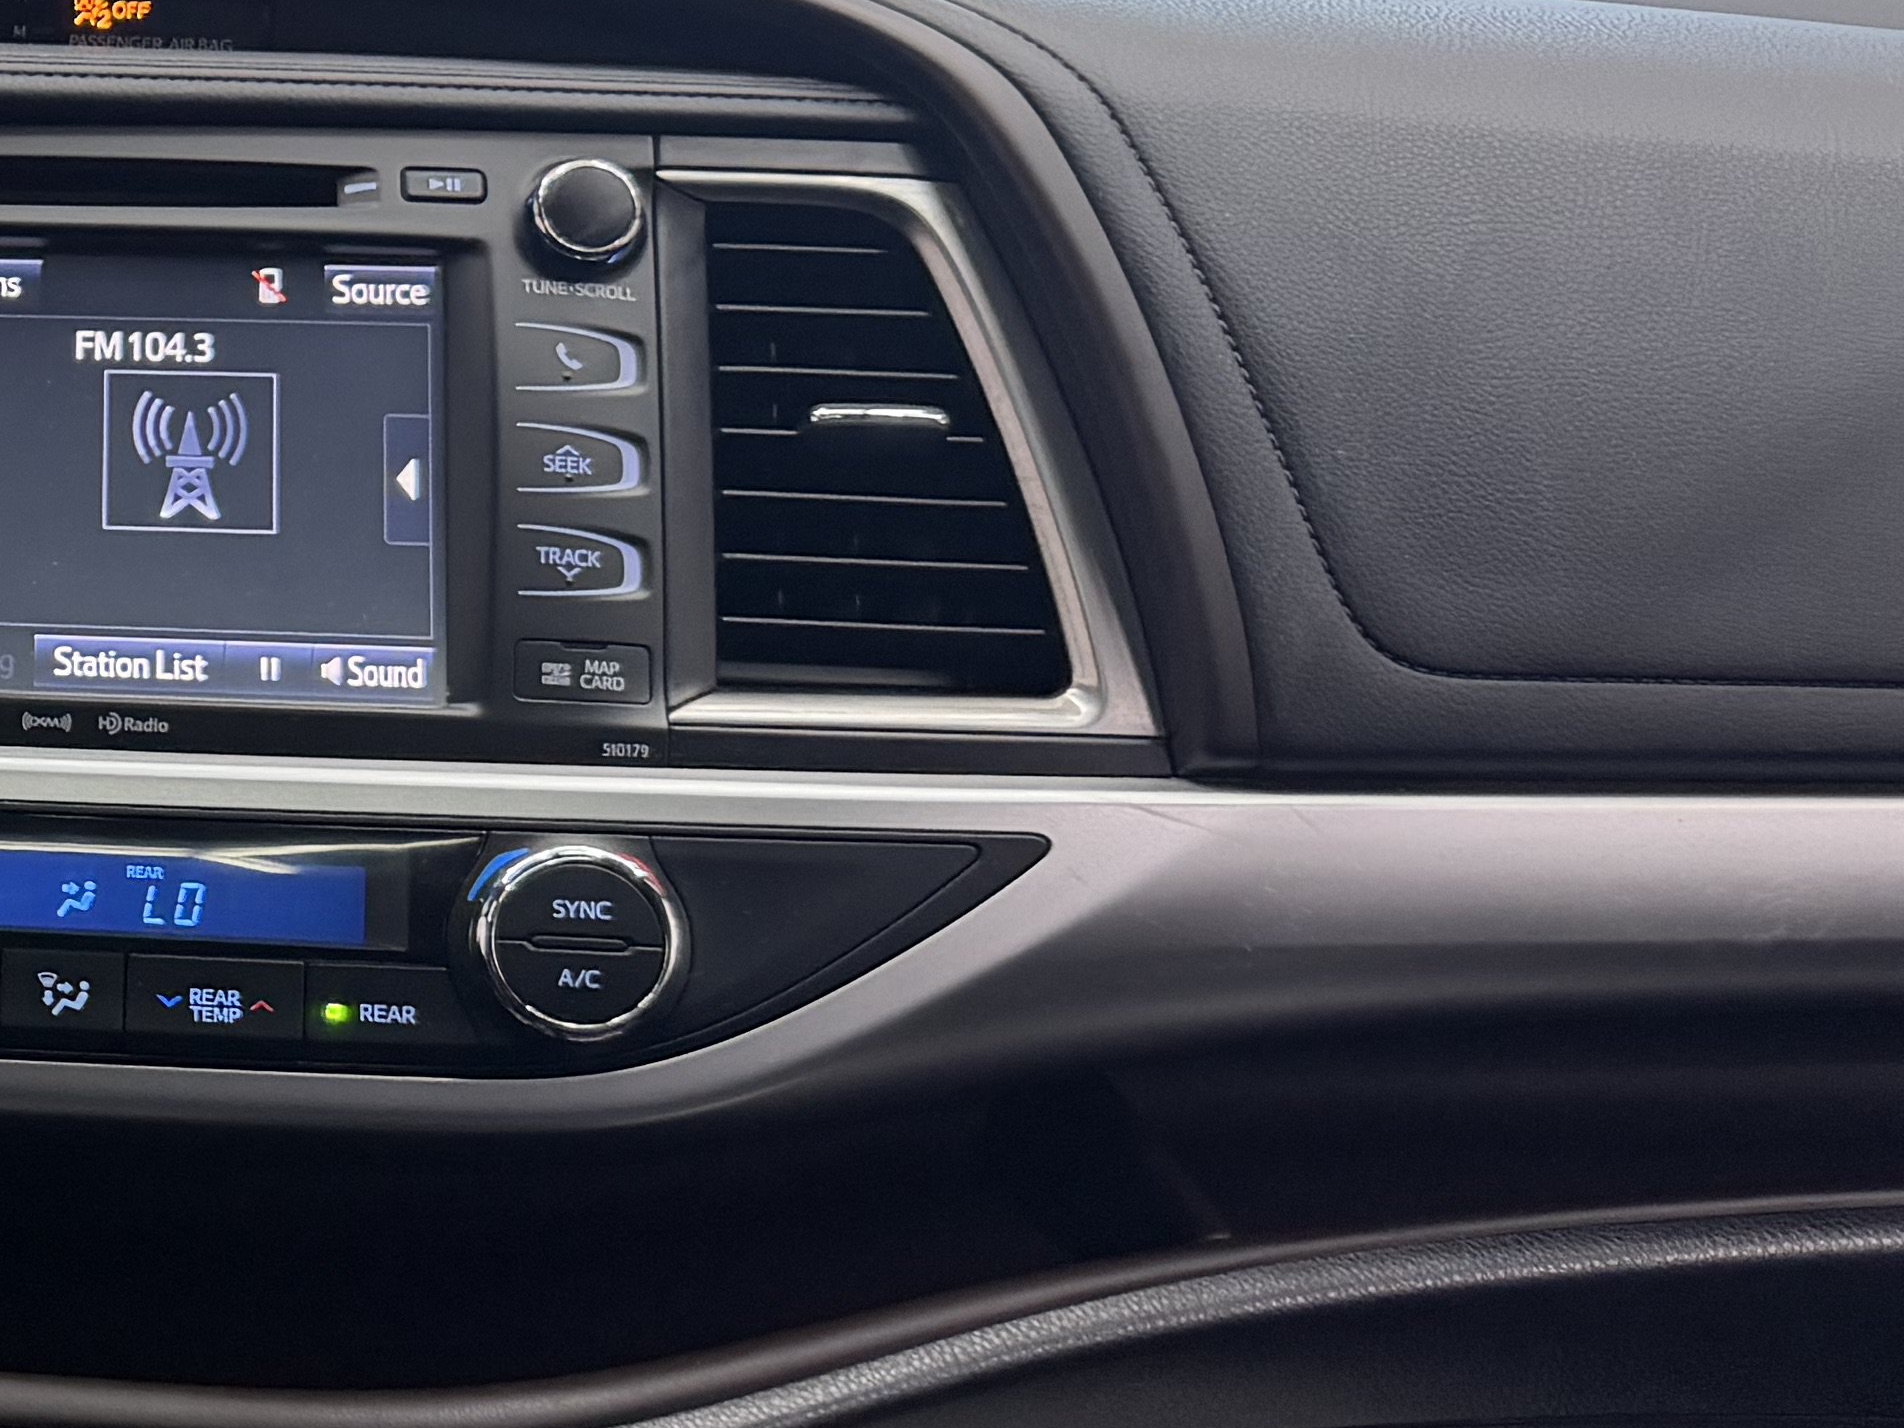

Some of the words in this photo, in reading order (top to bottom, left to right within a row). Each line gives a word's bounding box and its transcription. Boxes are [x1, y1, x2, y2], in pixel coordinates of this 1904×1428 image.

[112, 0, 152, 20] OFF
[331, 273, 431, 307] Source
[542, 454, 593, 476] SEEK
[535, 545, 602, 570] TRACK
[52, 646, 151, 681] Station
[155, 650, 209, 682] List
[347, 656, 425, 690] Sound
[584, 659, 620, 675] MAP
[579, 674, 625, 692] CARD
[123, 716, 170, 733] Radio
[125, 864, 165, 881] REAR
[142, 881, 208, 928] LO
[552, 898, 614, 922] SYNC
[558, 969, 602, 990] A/C
[188, 987, 243, 1006] REAR
[189, 1004, 245, 1024] TEMP
[359, 1003, 417, 1025] REAR
